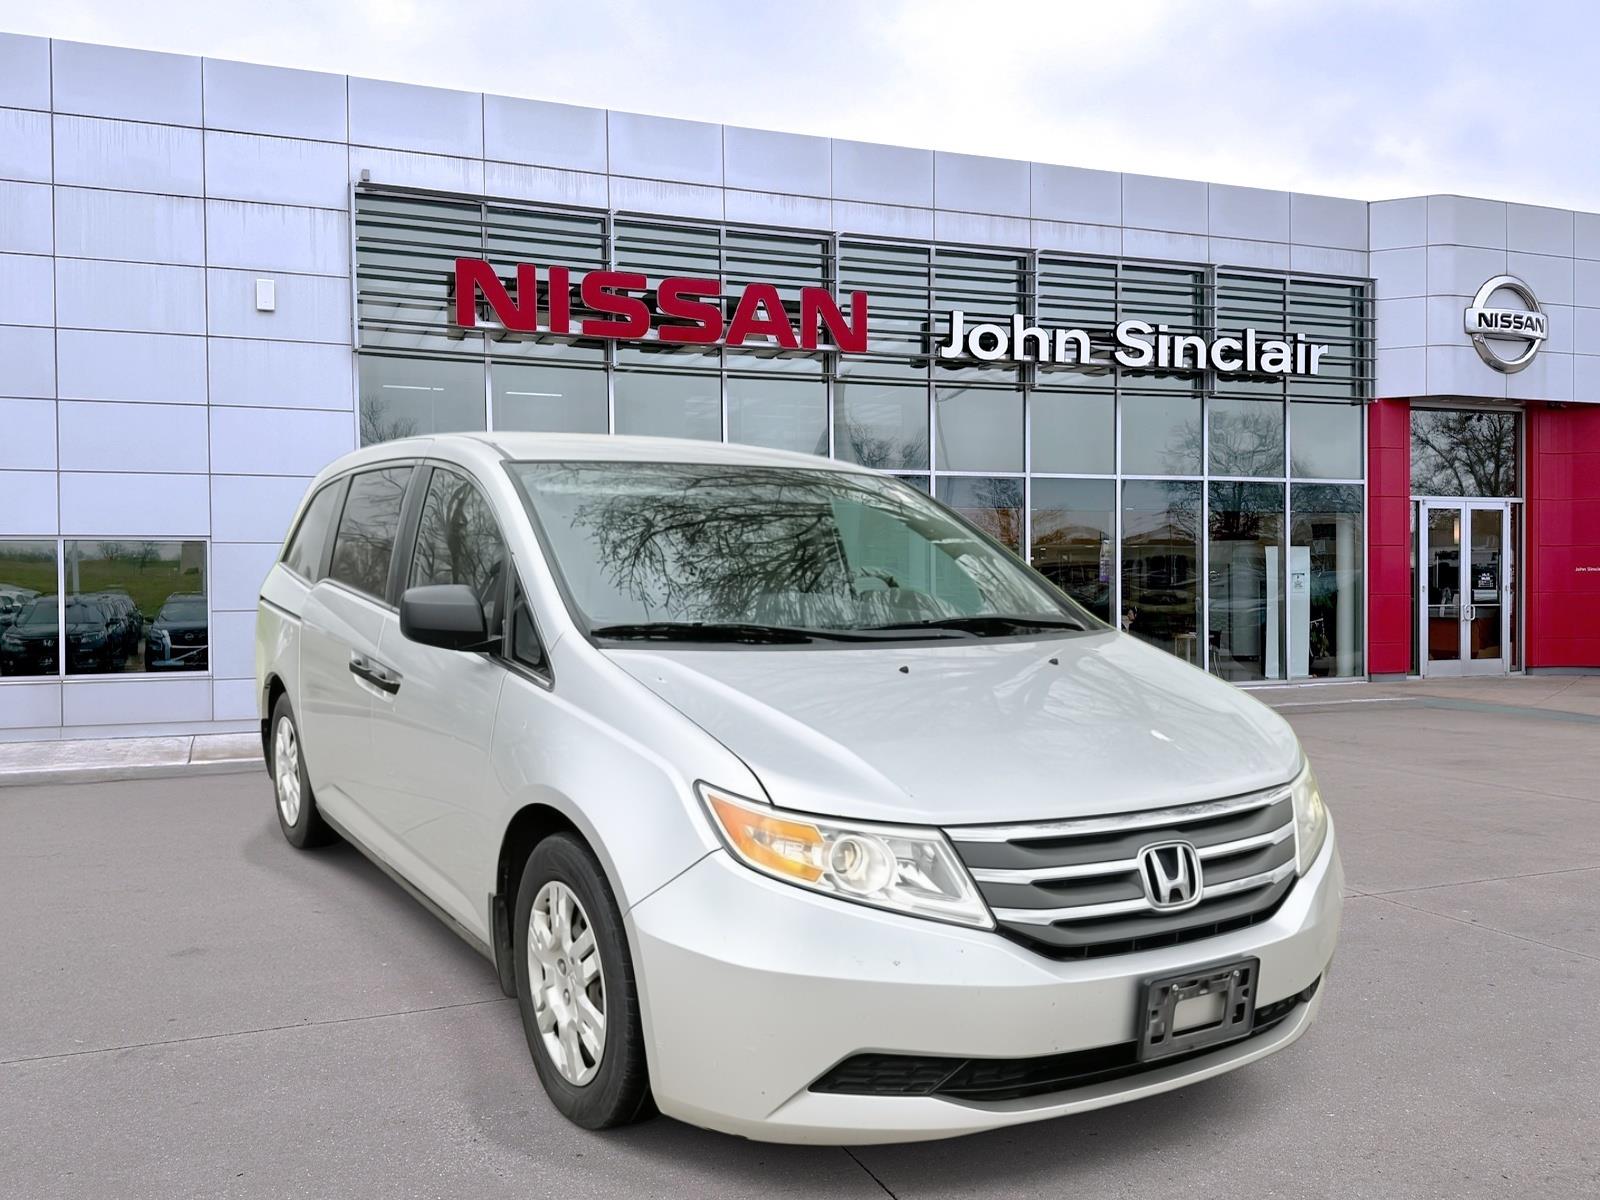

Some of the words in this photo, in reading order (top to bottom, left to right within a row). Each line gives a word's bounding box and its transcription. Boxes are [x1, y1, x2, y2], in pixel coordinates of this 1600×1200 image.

[455, 258, 868, 352] NISSAN
[1478, 312, 1545, 333] NISSAN
[940, 310, 1091, 364] John
[1113, 319, 1329, 375] Sinclair
